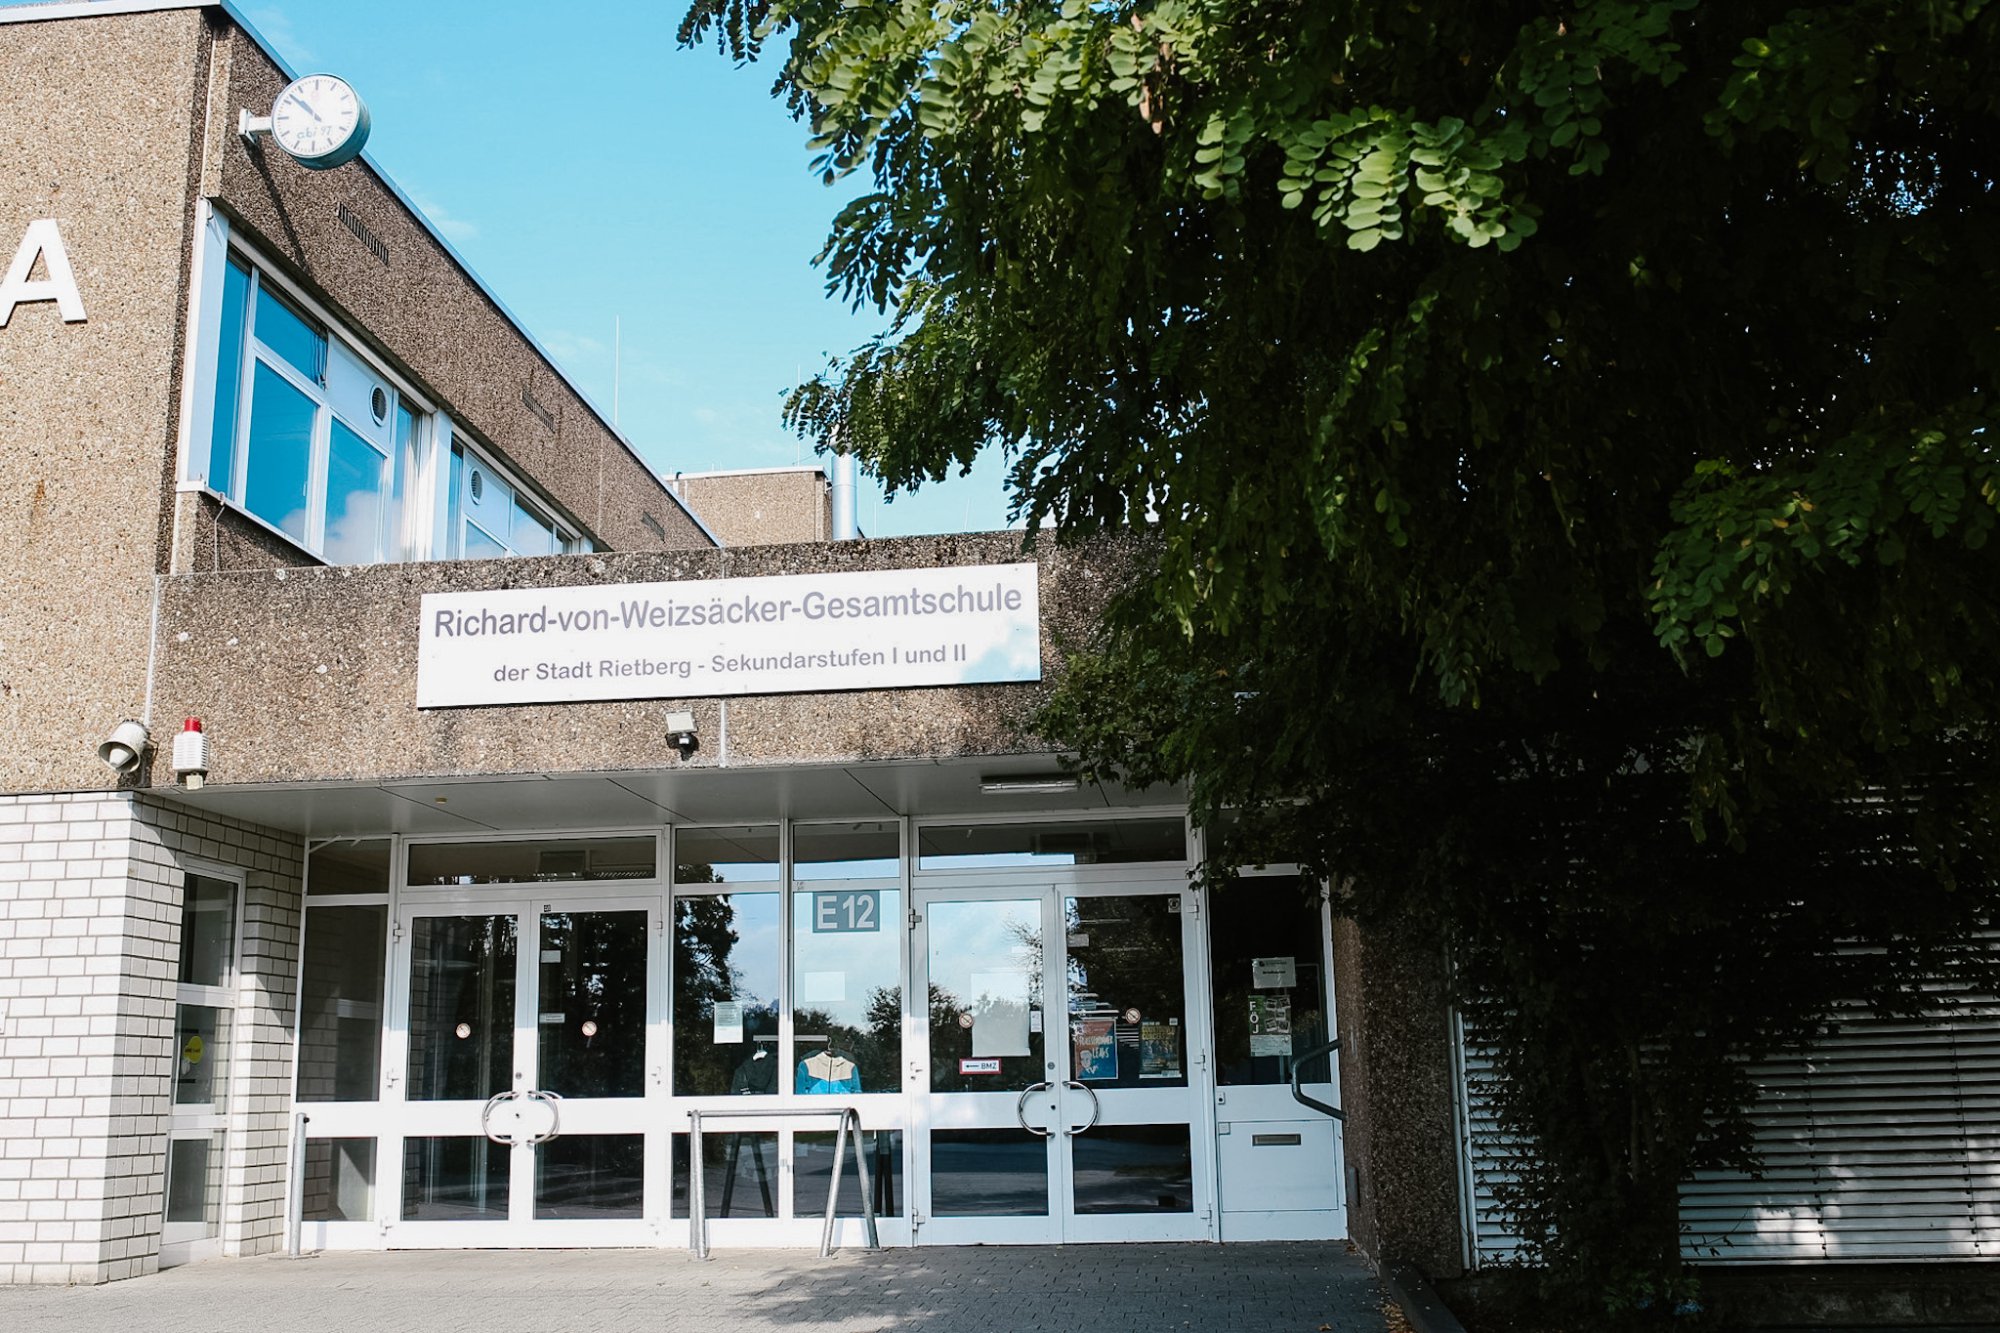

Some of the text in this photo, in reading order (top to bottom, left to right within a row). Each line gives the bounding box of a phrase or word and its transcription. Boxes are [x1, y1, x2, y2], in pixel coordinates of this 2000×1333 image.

[0, 218, 88, 329] A
[434, 582, 1022, 638] Richard-von-Weizsäcker-Gesamtschule
[493, 664, 530, 682] der
[535, 661, 593, 681] Stadt
[599, 658, 692, 679] Rietberg
[711, 648, 885, 673] Sekundarstufen
[892, 646, 897, 665] I
[905, 644, 946, 664] und
[954, 643, 966, 662] II
[980, 1062, 998, 1070] BMZ
